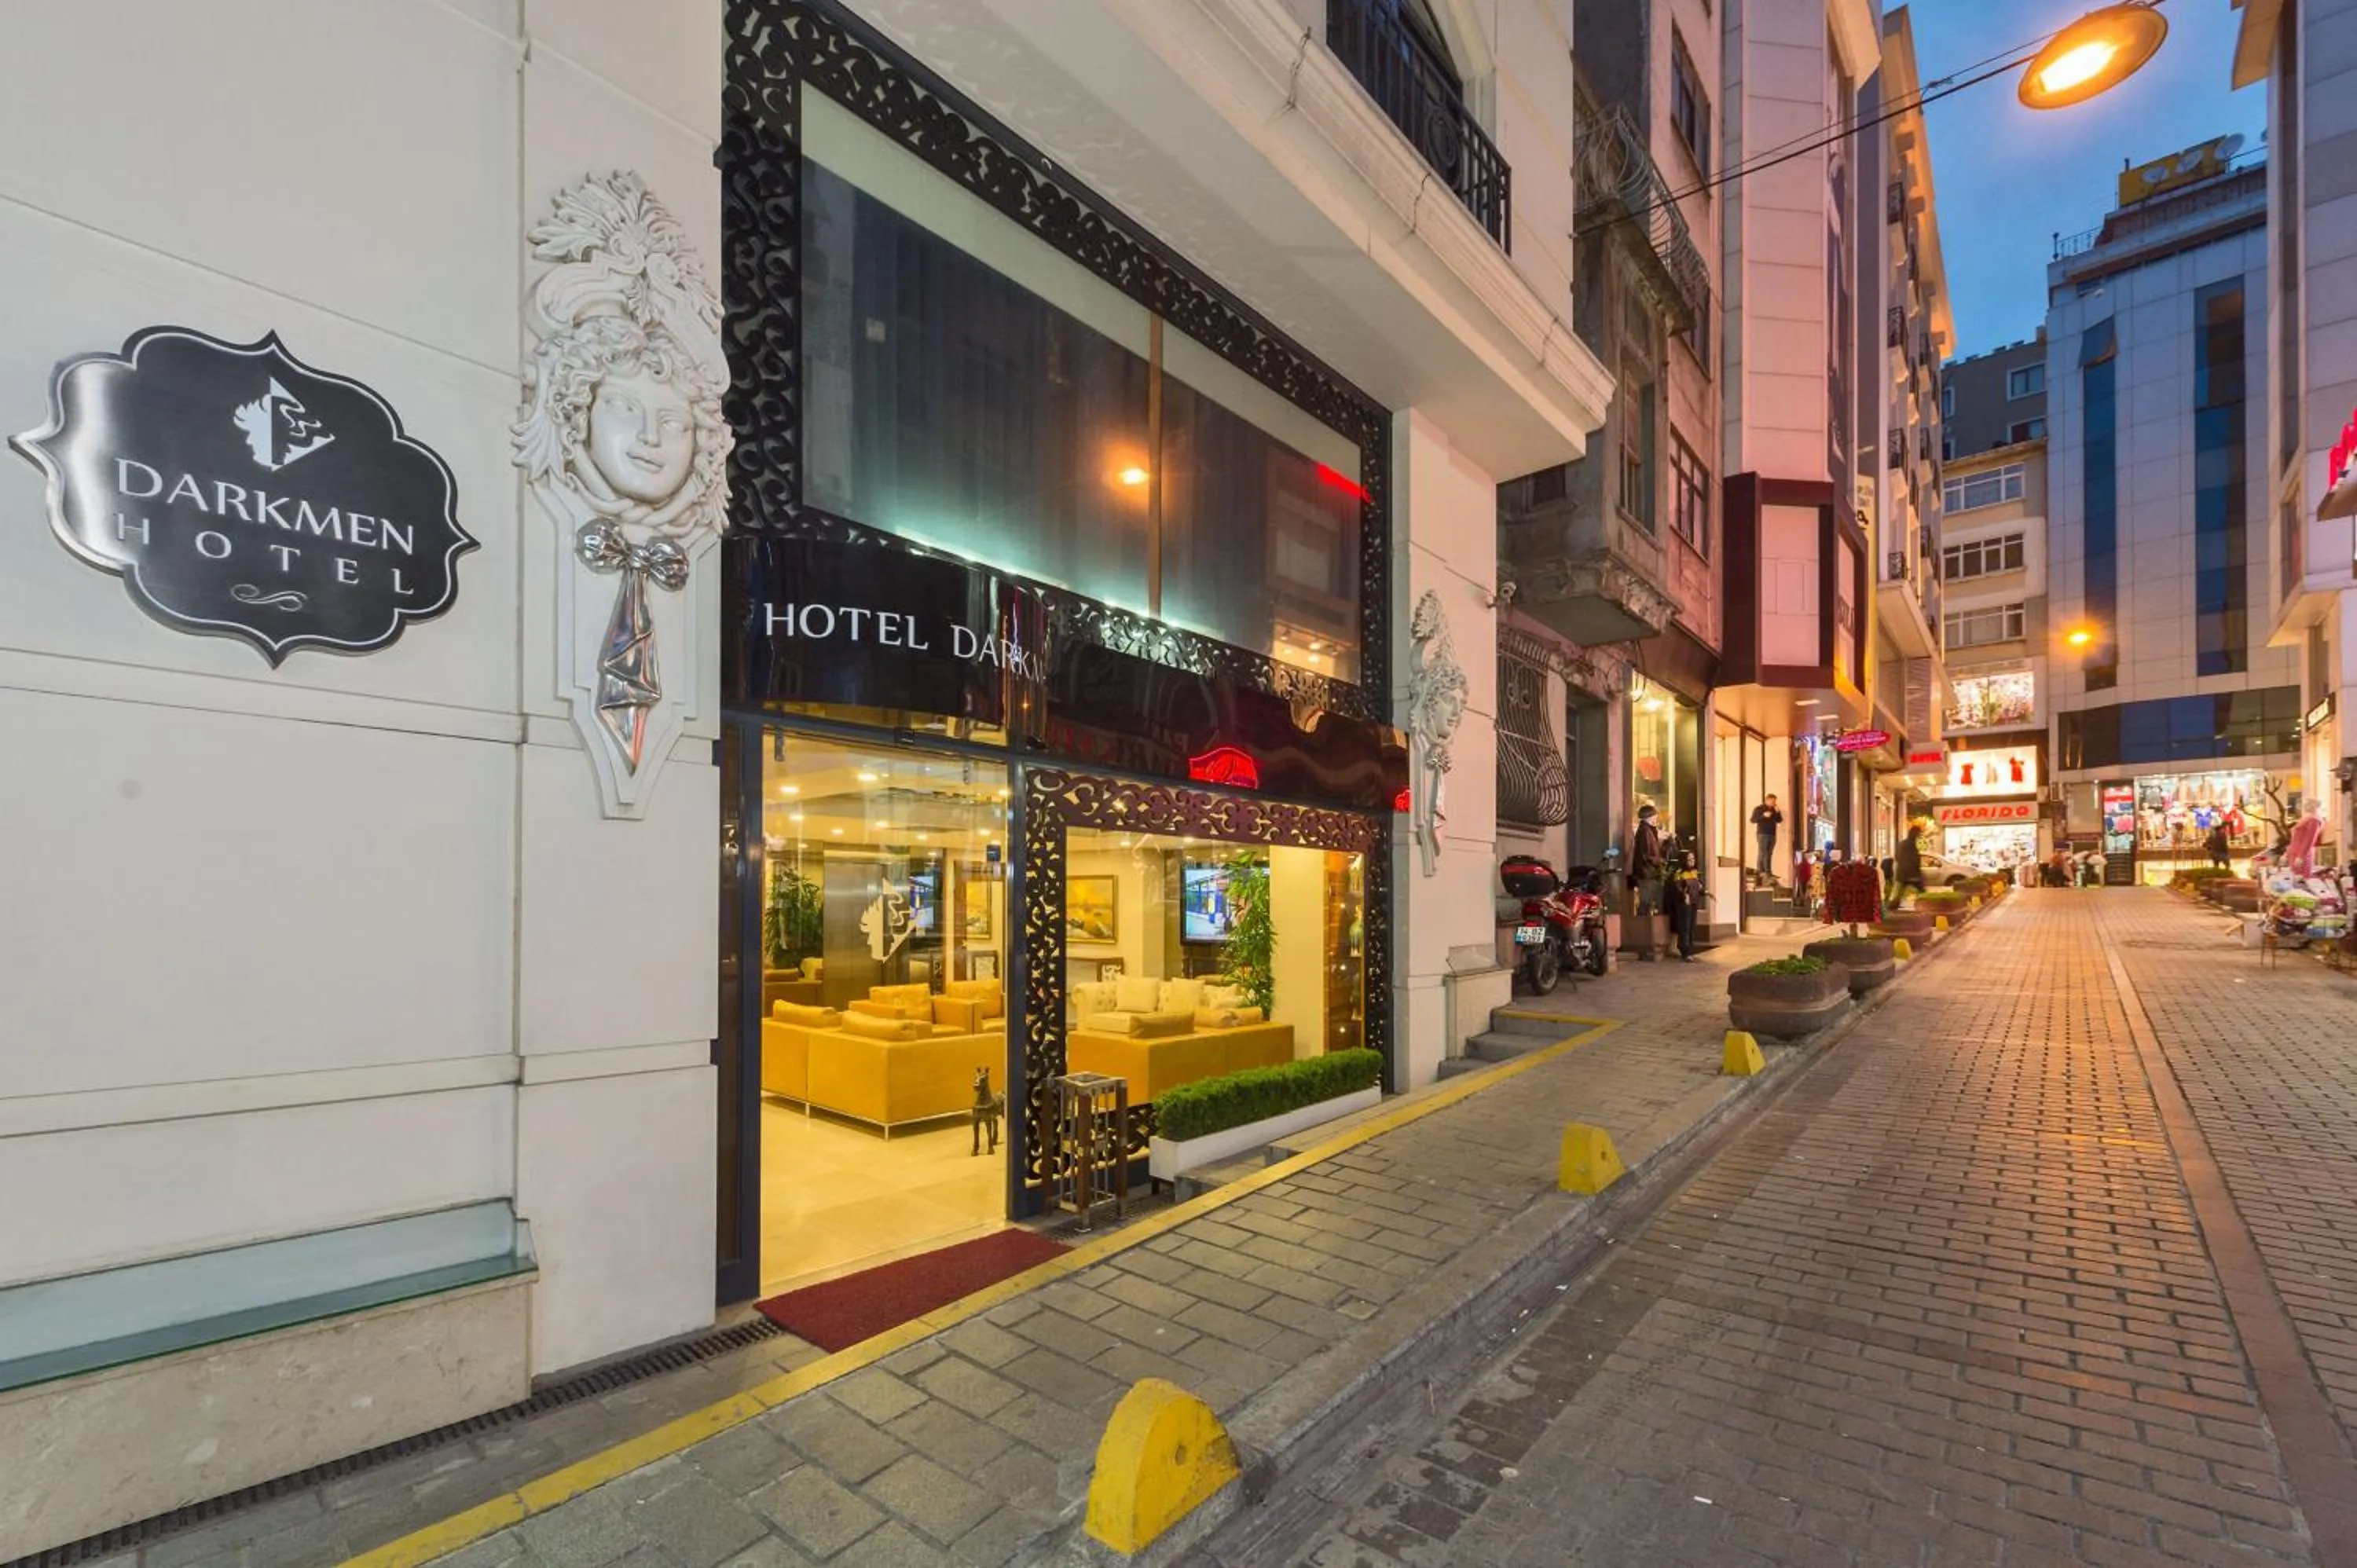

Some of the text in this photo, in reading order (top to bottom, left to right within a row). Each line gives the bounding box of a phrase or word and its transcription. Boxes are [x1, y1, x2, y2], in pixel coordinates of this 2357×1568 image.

[115, 457, 414, 555] DARKMEN
[115, 512, 414, 595] HOTEL
[764, 603, 929, 651] HOTEL
